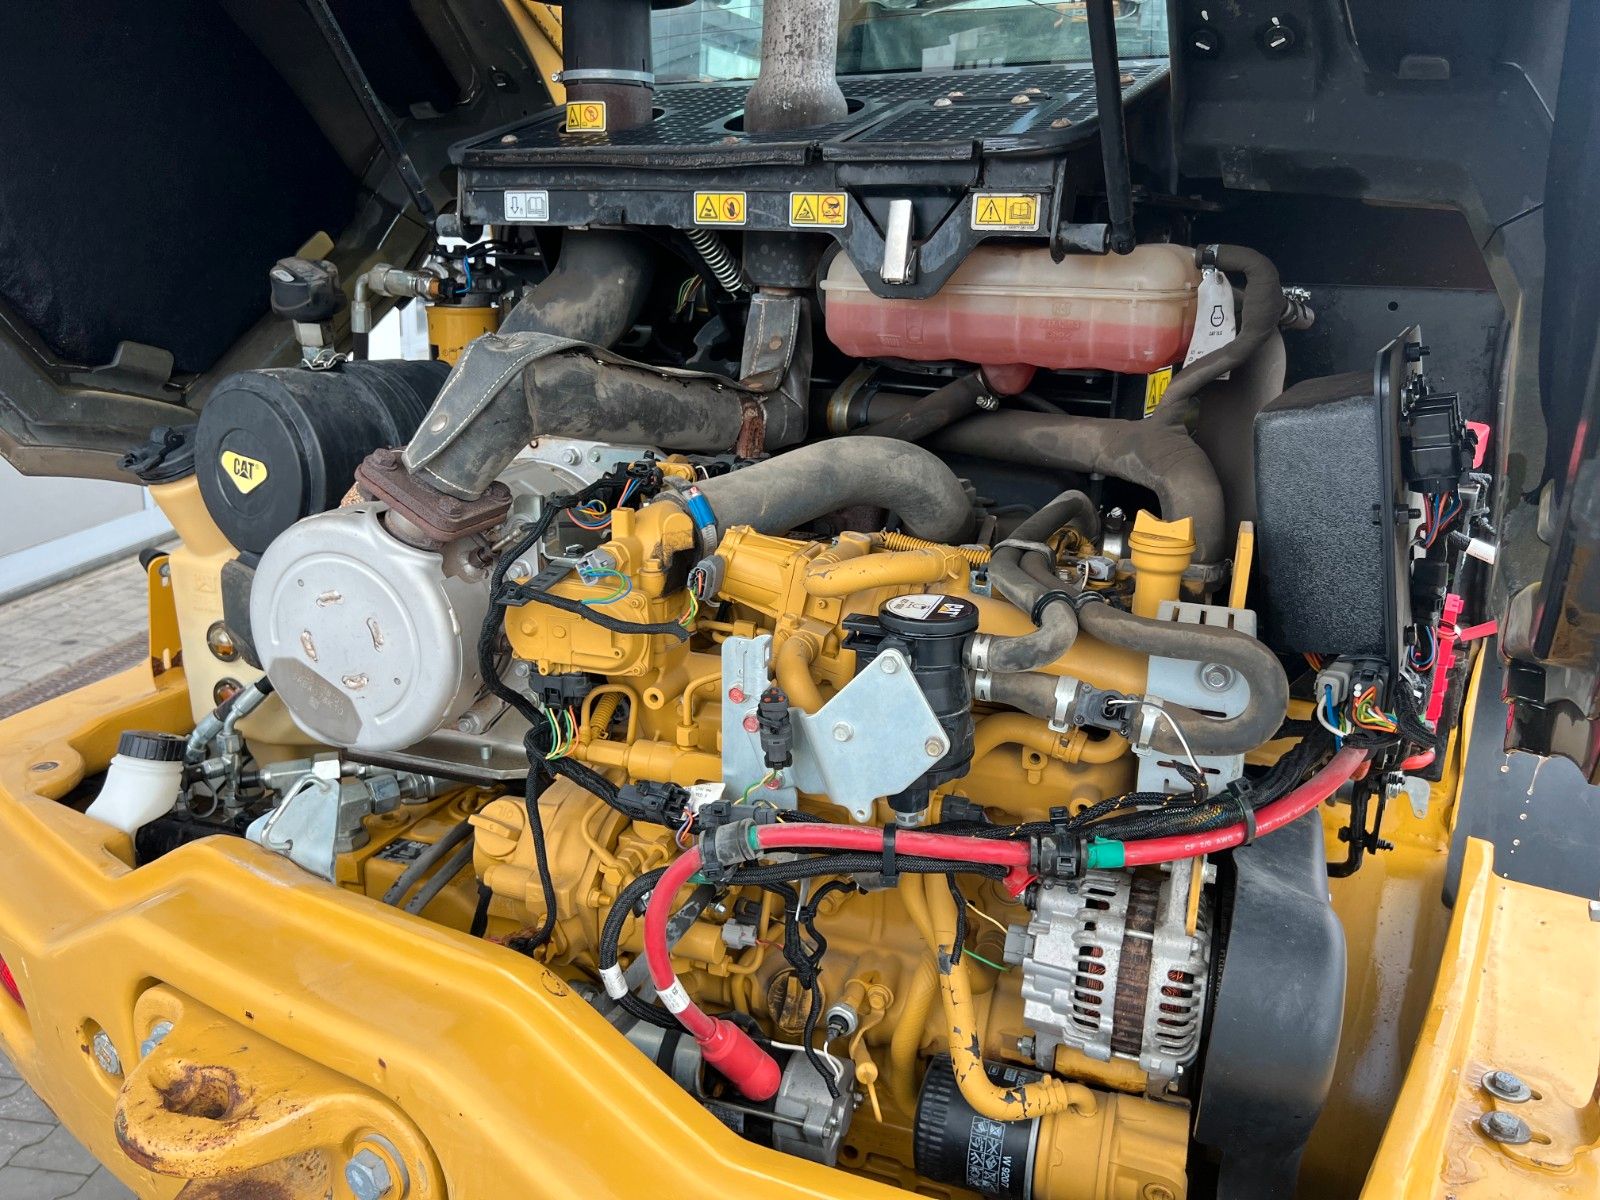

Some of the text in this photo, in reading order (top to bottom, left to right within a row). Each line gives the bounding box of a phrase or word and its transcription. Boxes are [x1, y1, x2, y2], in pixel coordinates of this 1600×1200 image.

[233, 457, 255, 480] CAT
[937, 603, 965, 618] CAT
[1216, 836, 1233, 846] AWG
[1003, 1156, 1012, 1167] W
